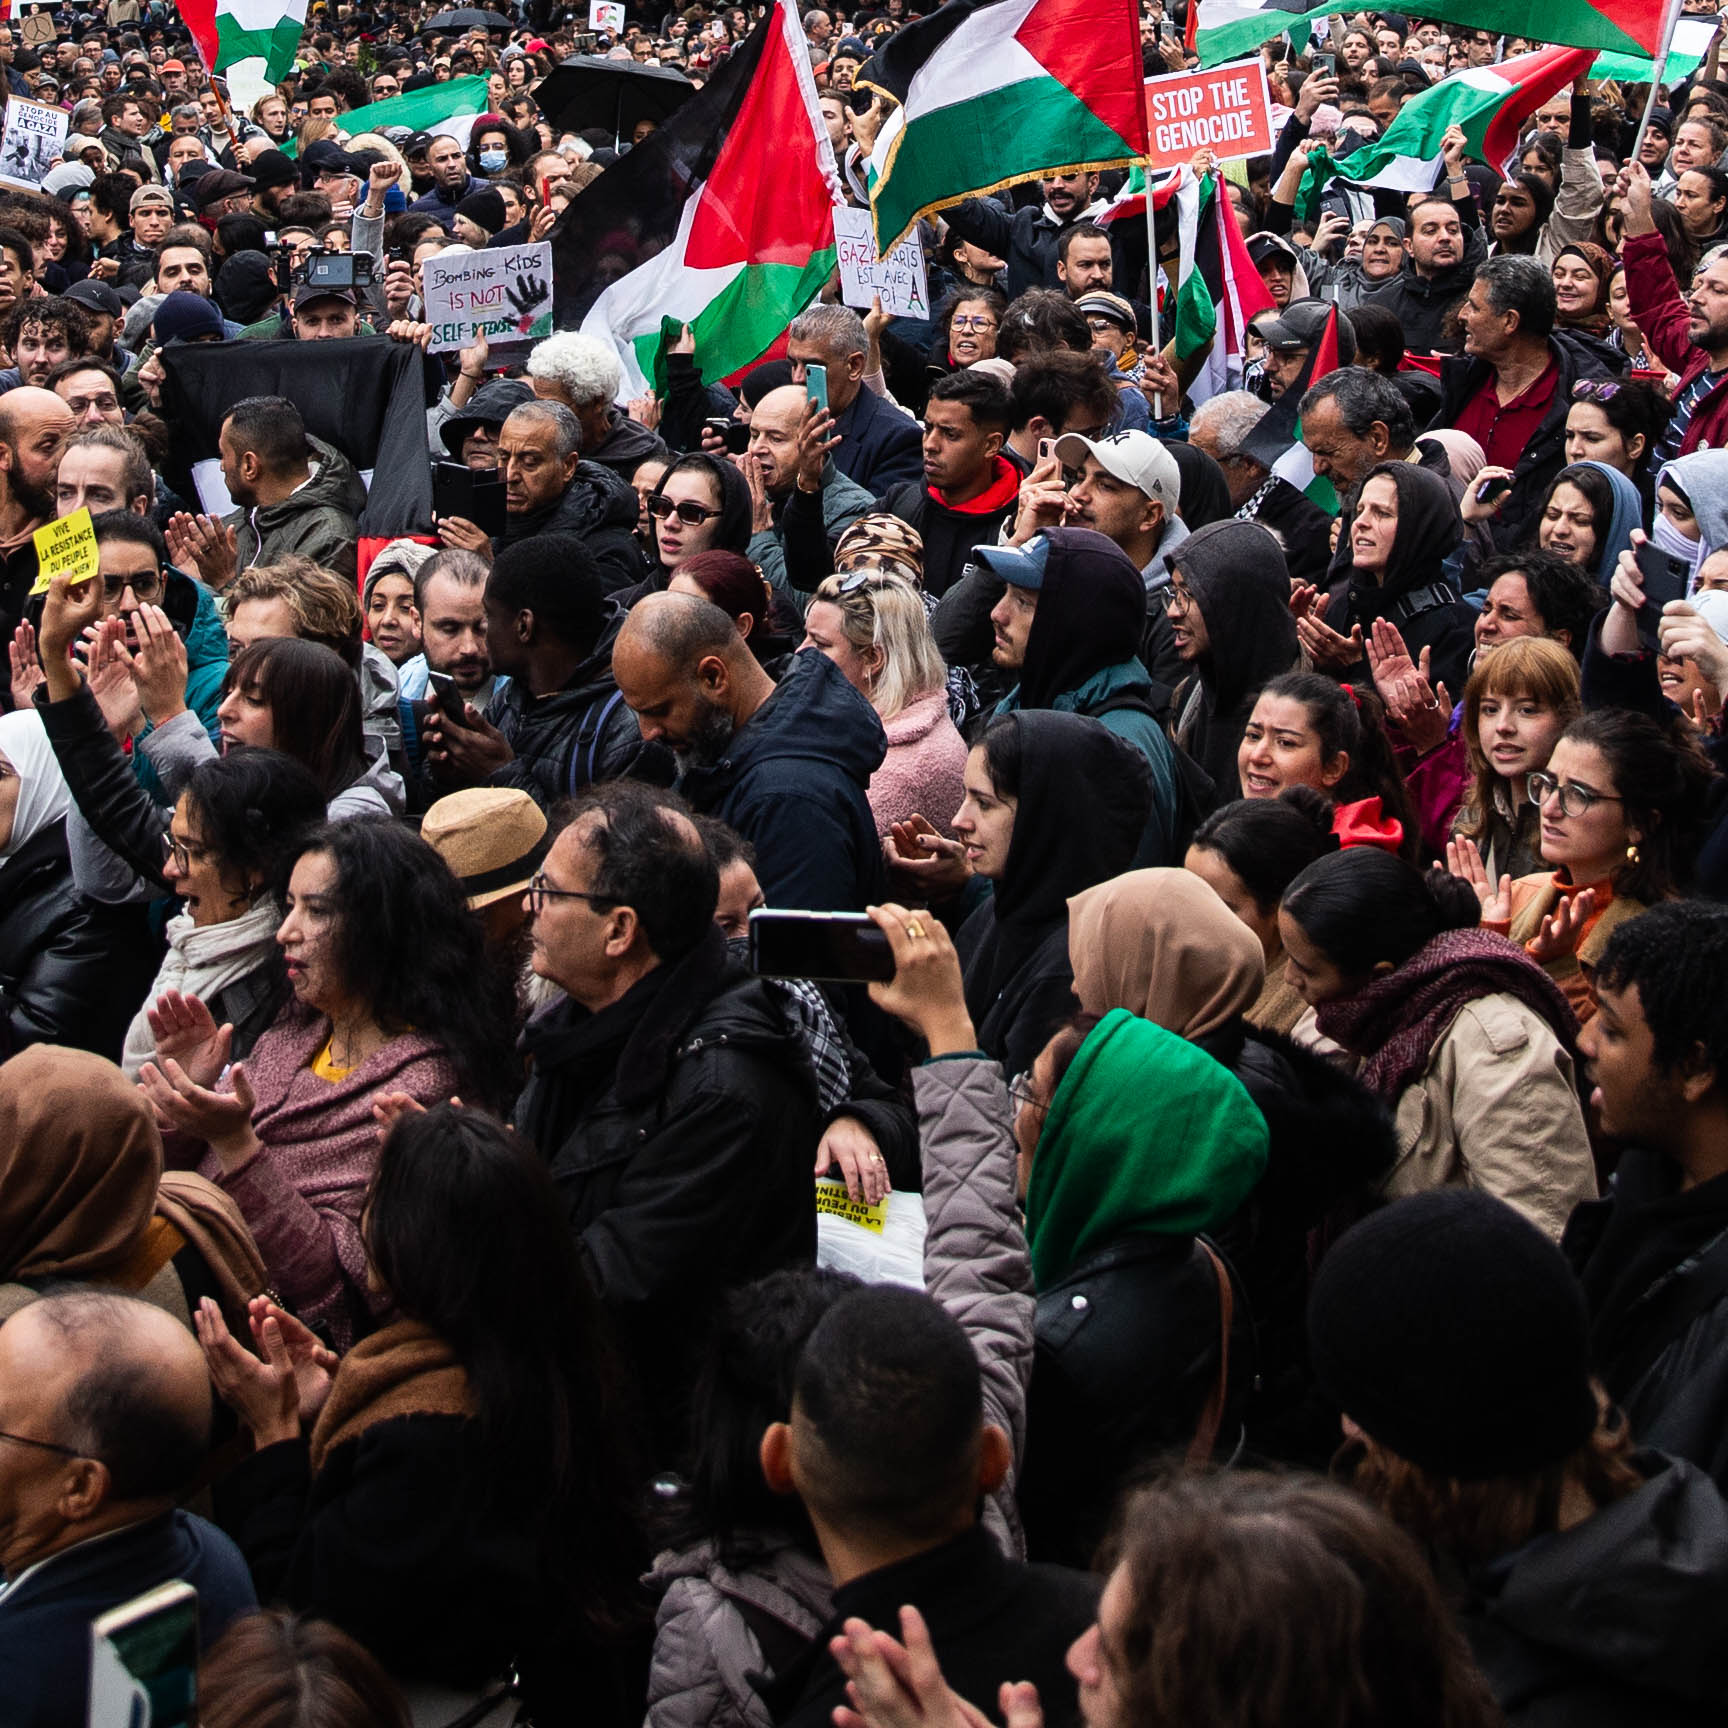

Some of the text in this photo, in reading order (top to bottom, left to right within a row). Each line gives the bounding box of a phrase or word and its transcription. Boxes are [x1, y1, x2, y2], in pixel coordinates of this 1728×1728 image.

[1152, 77, 1251, 121] STOP THE
[20, 104, 58, 120] STOP AU
[26, 122, 57, 137] GAZA
[1155, 109, 1256, 153] GENOCIDE
[886, 247, 919, 268] ARIS
[857, 266, 910, 286] EST AVEC
[470, 284, 507, 308] NOT
[871, 285, 897, 305] TOI
[432, 319, 513, 345] SELF-DFENSE
[53, 521, 71, 538] VIVE
[40, 548, 51, 562] LA
[51, 546, 89, 574] DU PEUPLE
[851, 1205, 869, 1216] DU
[866, 1216, 882, 1226] LA
